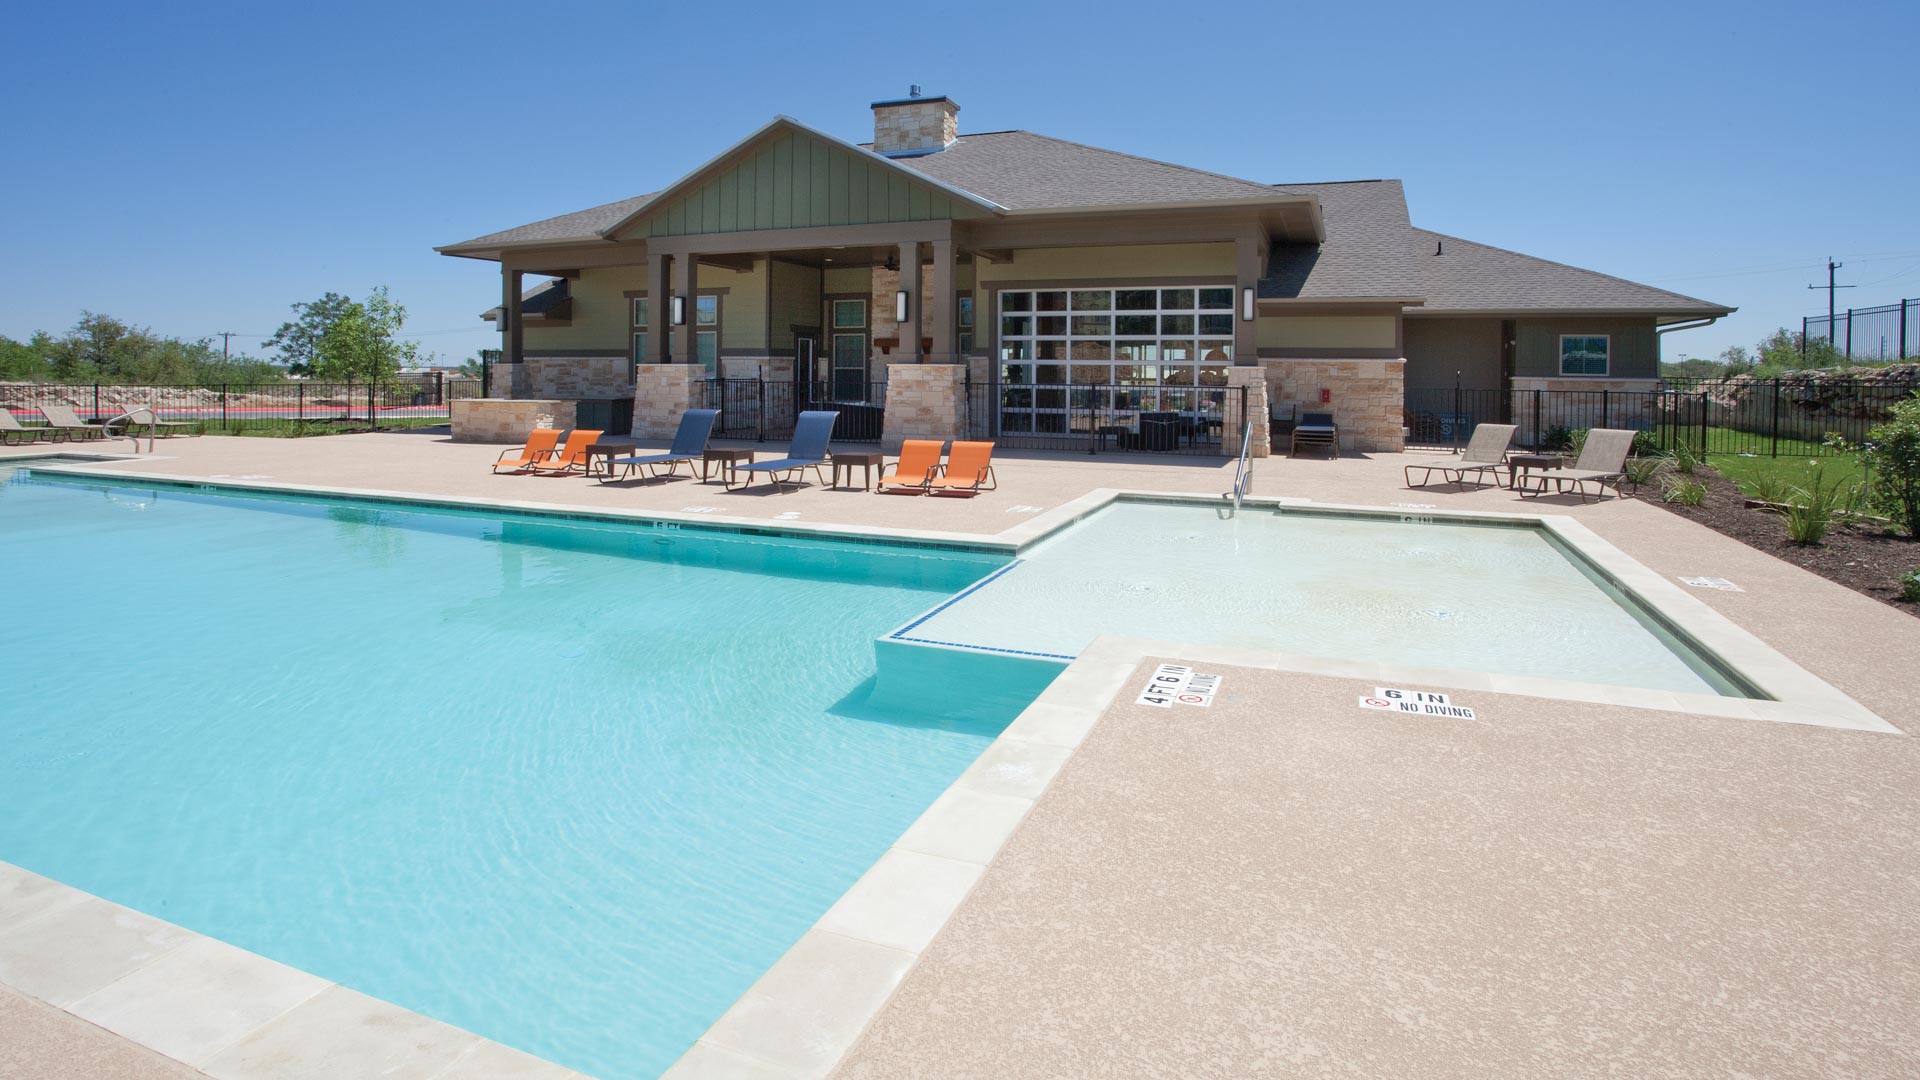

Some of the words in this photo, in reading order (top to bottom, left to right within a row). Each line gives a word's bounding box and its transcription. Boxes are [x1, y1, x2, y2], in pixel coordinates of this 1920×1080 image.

[1160, 665, 1187, 675] IN
[1146, 684, 1175, 695] FT
[1143, 696, 1169, 704] 4
[1384, 690, 1402, 699] 6
[1417, 692, 1444, 703] IN
[1399, 702, 1418, 712] NO
[1425, 704, 1472, 718] DIVING
